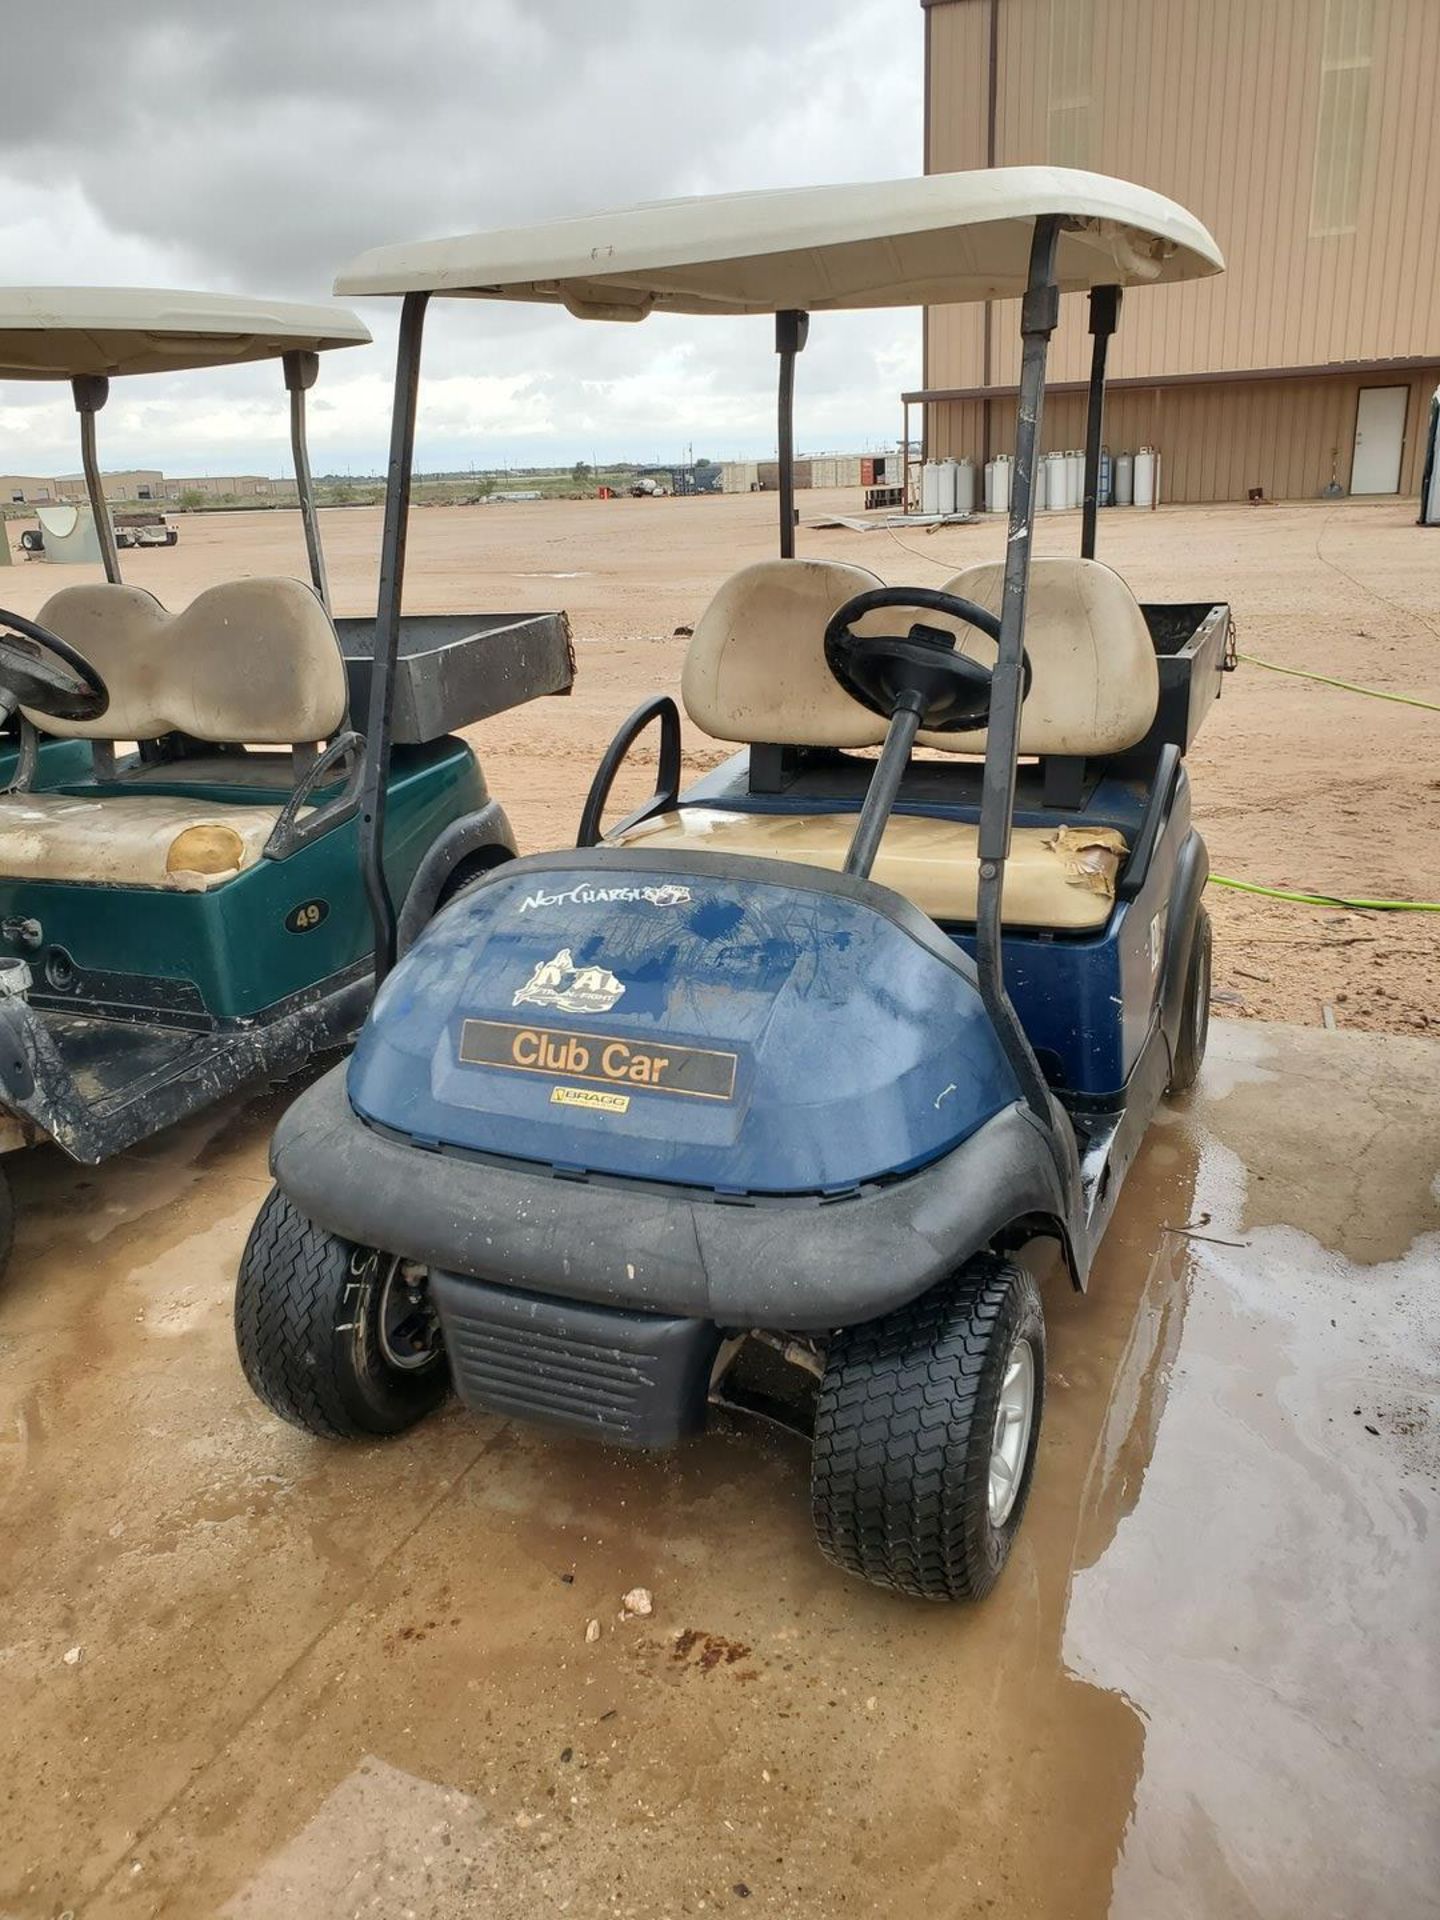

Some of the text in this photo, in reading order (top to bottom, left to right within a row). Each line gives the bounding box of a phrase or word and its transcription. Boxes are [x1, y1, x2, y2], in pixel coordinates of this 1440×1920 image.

[297, 904, 320, 926] 49
[512, 1031, 669, 1083] Club Car
[565, 1090, 625, 1106] BRAGG
